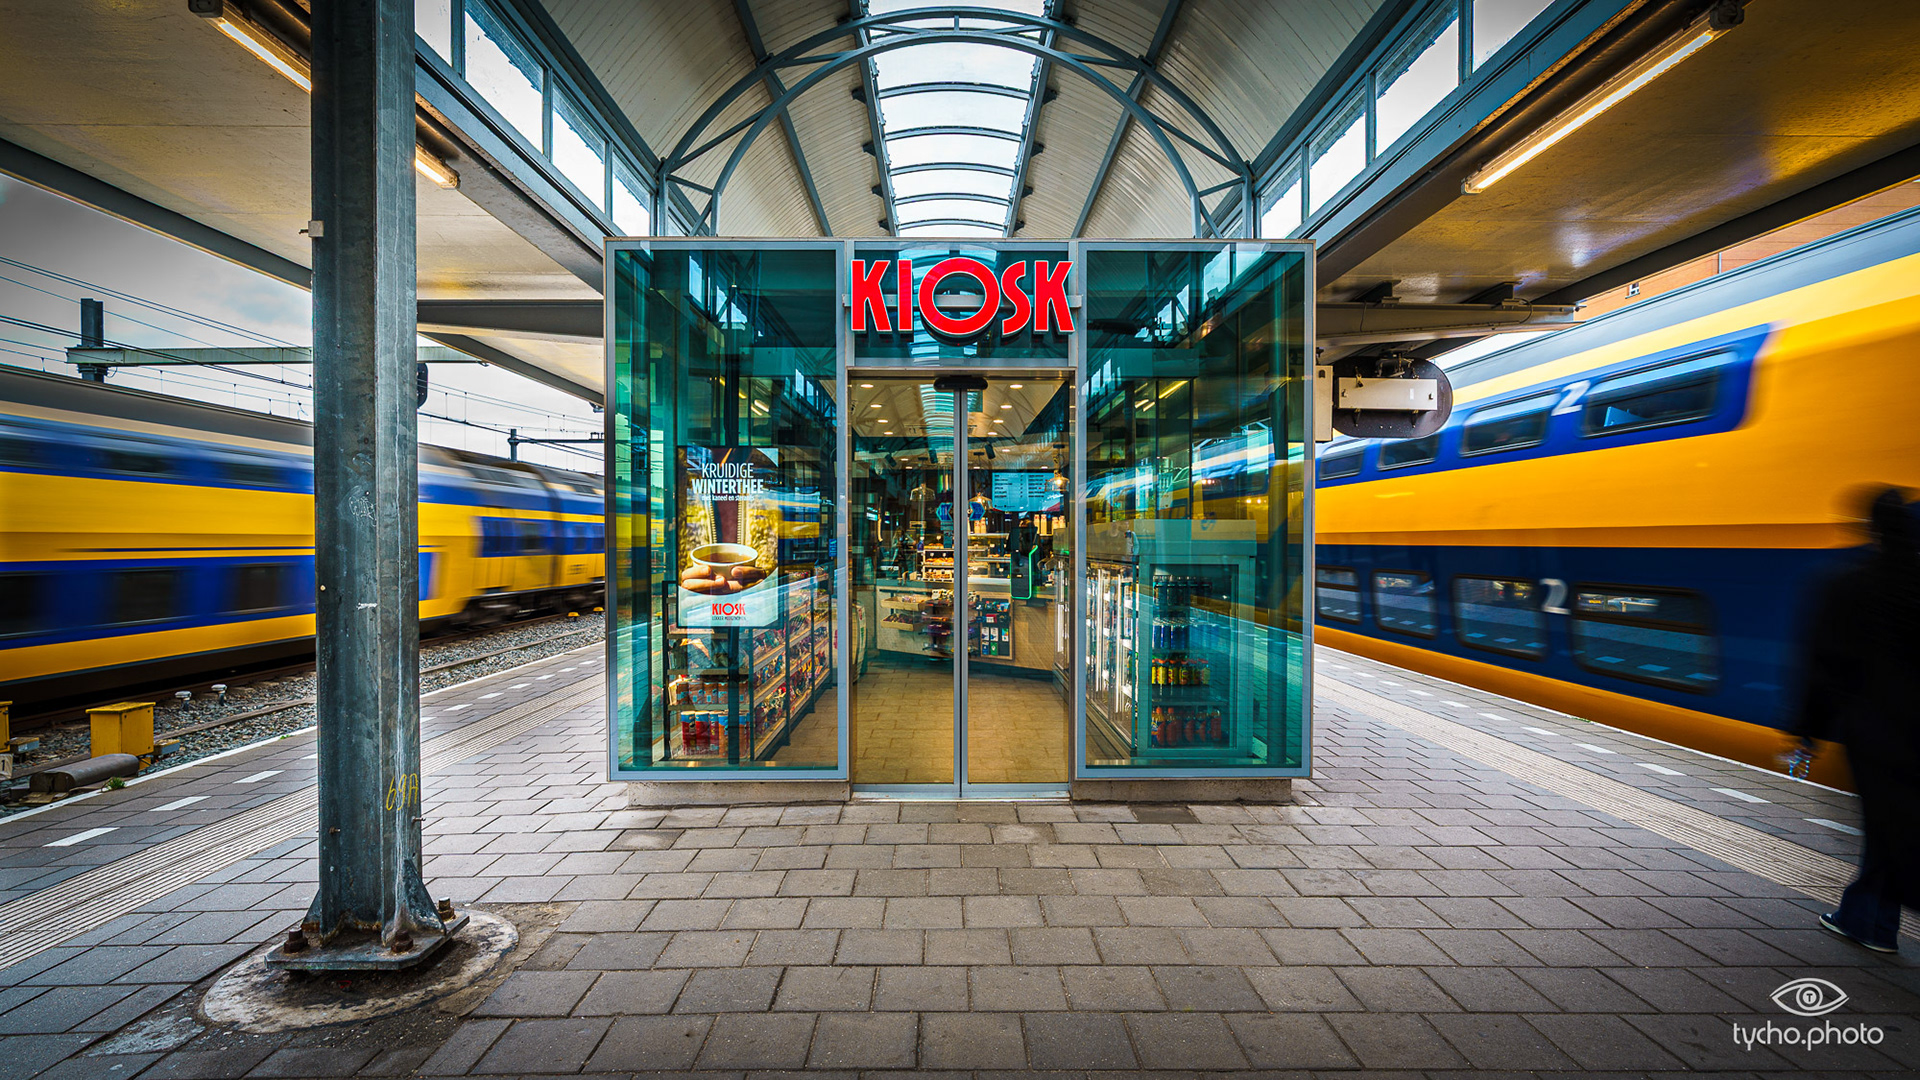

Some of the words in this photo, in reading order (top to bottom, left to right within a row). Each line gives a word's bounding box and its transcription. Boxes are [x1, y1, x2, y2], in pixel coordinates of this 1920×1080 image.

[851, 257, 1075, 336] KIOSK
[1551, 380, 1591, 416] 2
[701, 462, 754, 479] KRUIDIGE
[691, 478, 764, 494] WINTERTHEE
[711, 603, 746, 616] KIOSK
[1539, 578, 1572, 615] 2
